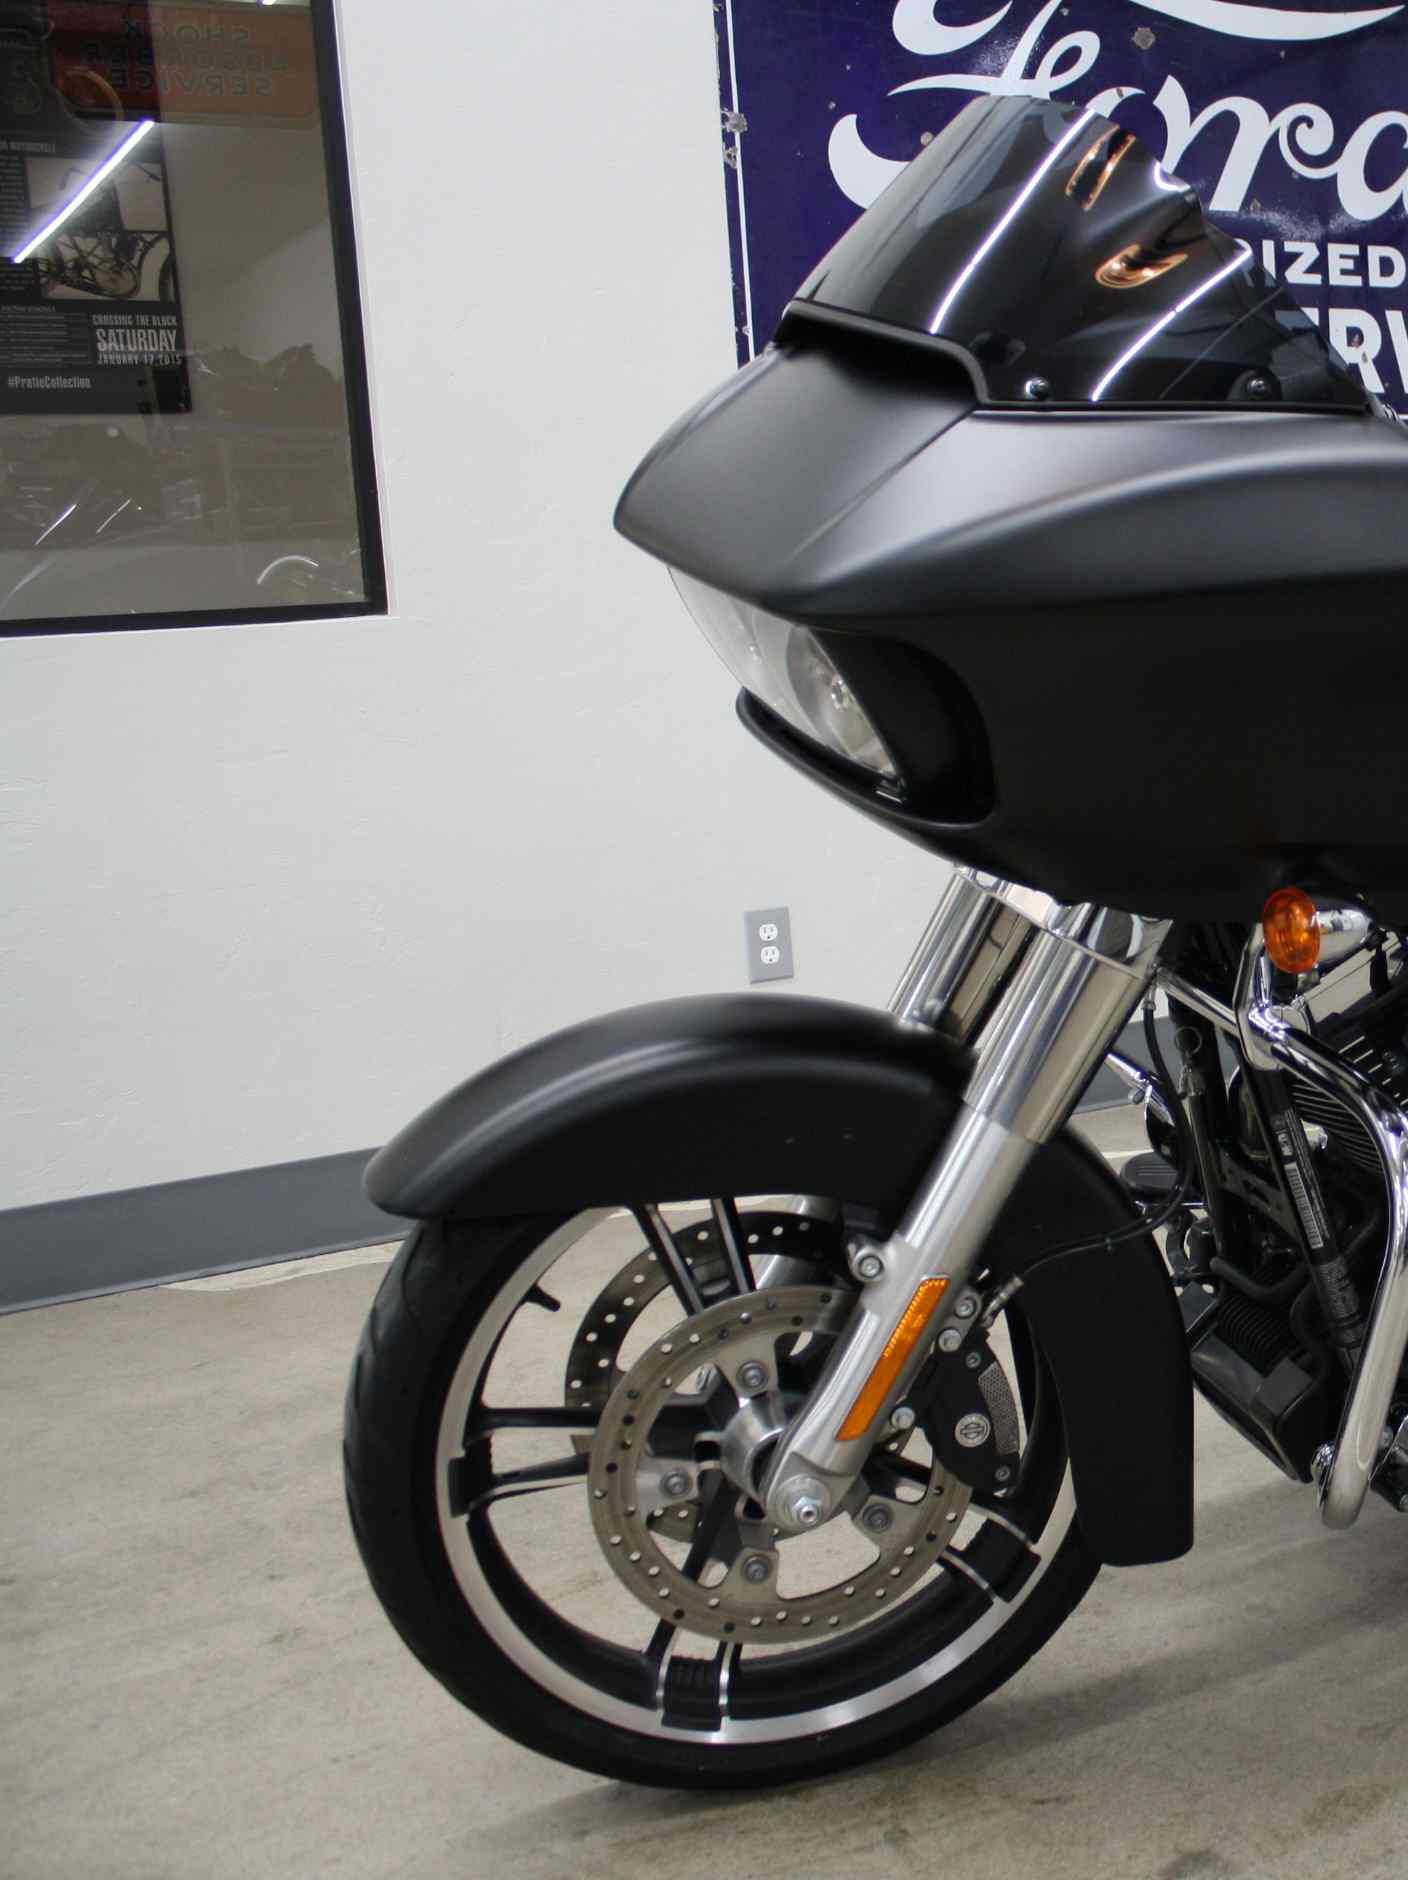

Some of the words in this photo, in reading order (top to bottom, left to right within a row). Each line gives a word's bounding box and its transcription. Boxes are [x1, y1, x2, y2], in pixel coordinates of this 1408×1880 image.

[92, 314, 133, 326] CROSSING
[136, 315, 150, 326] THE
[152, 315, 177, 327] BLOCK
[96, 328, 177, 353] SATURDAY
[98, 353, 139, 366] JANUARY
